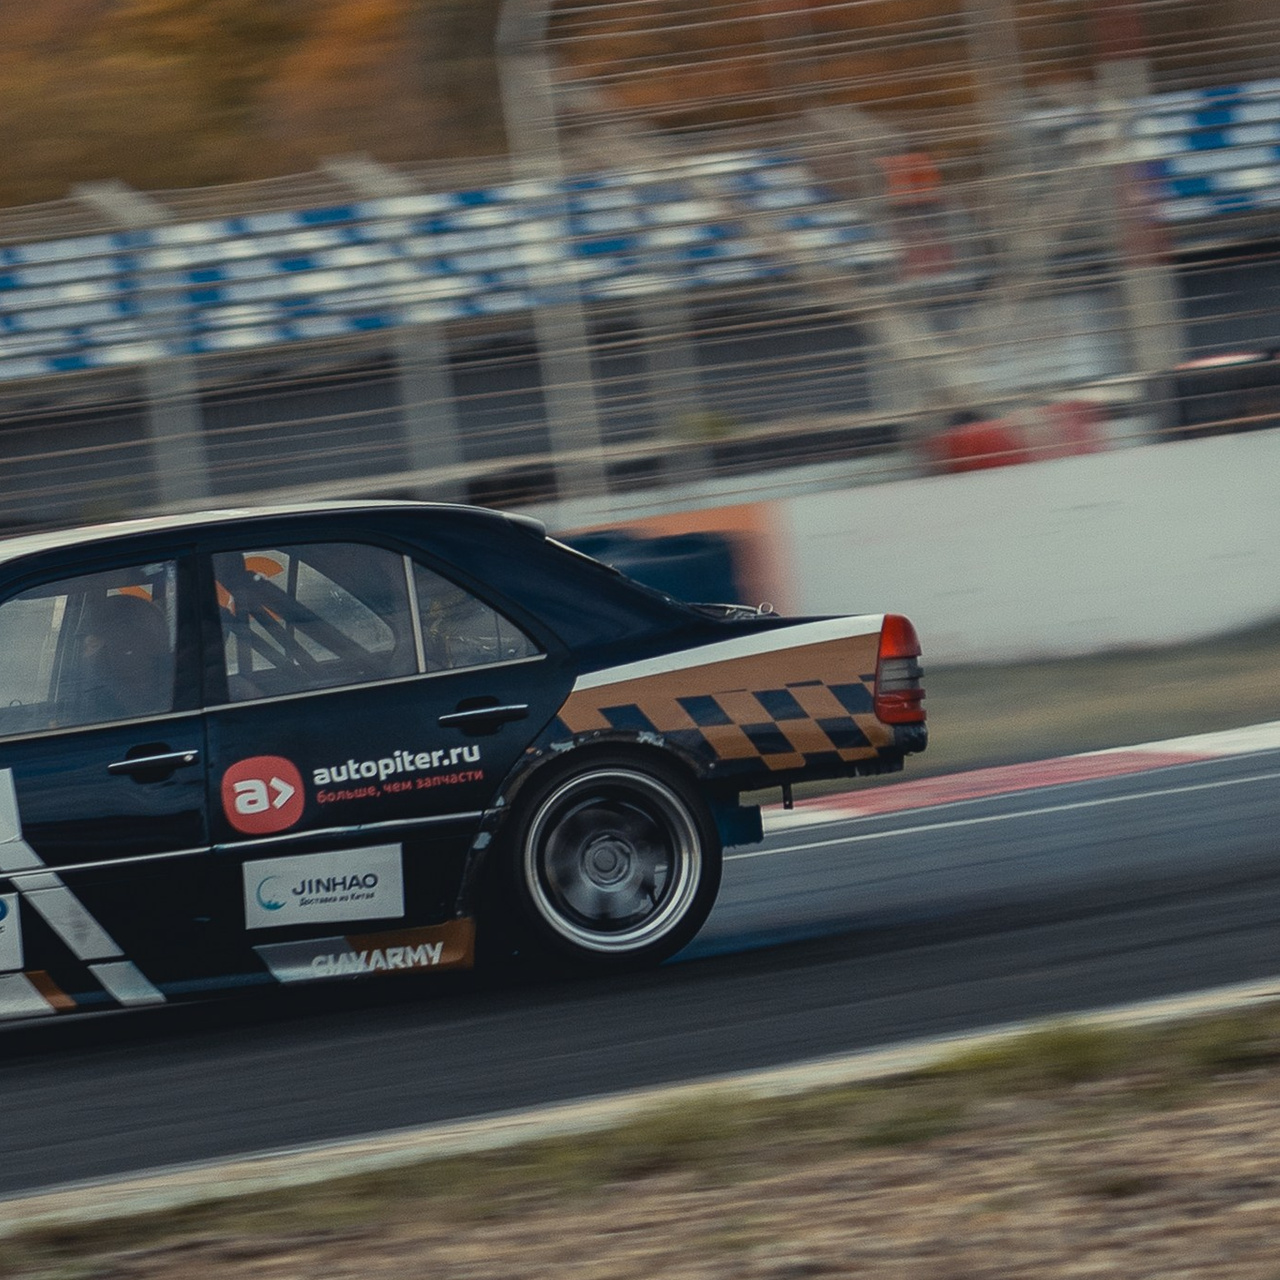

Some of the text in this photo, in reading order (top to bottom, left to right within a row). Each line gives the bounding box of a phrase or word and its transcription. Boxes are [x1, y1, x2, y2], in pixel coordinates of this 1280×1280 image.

[313, 744, 481, 787] autopiter.ru
[317, 769, 483, 804] больше, чем запчасти
[292, 873, 379, 896] JINHAO
